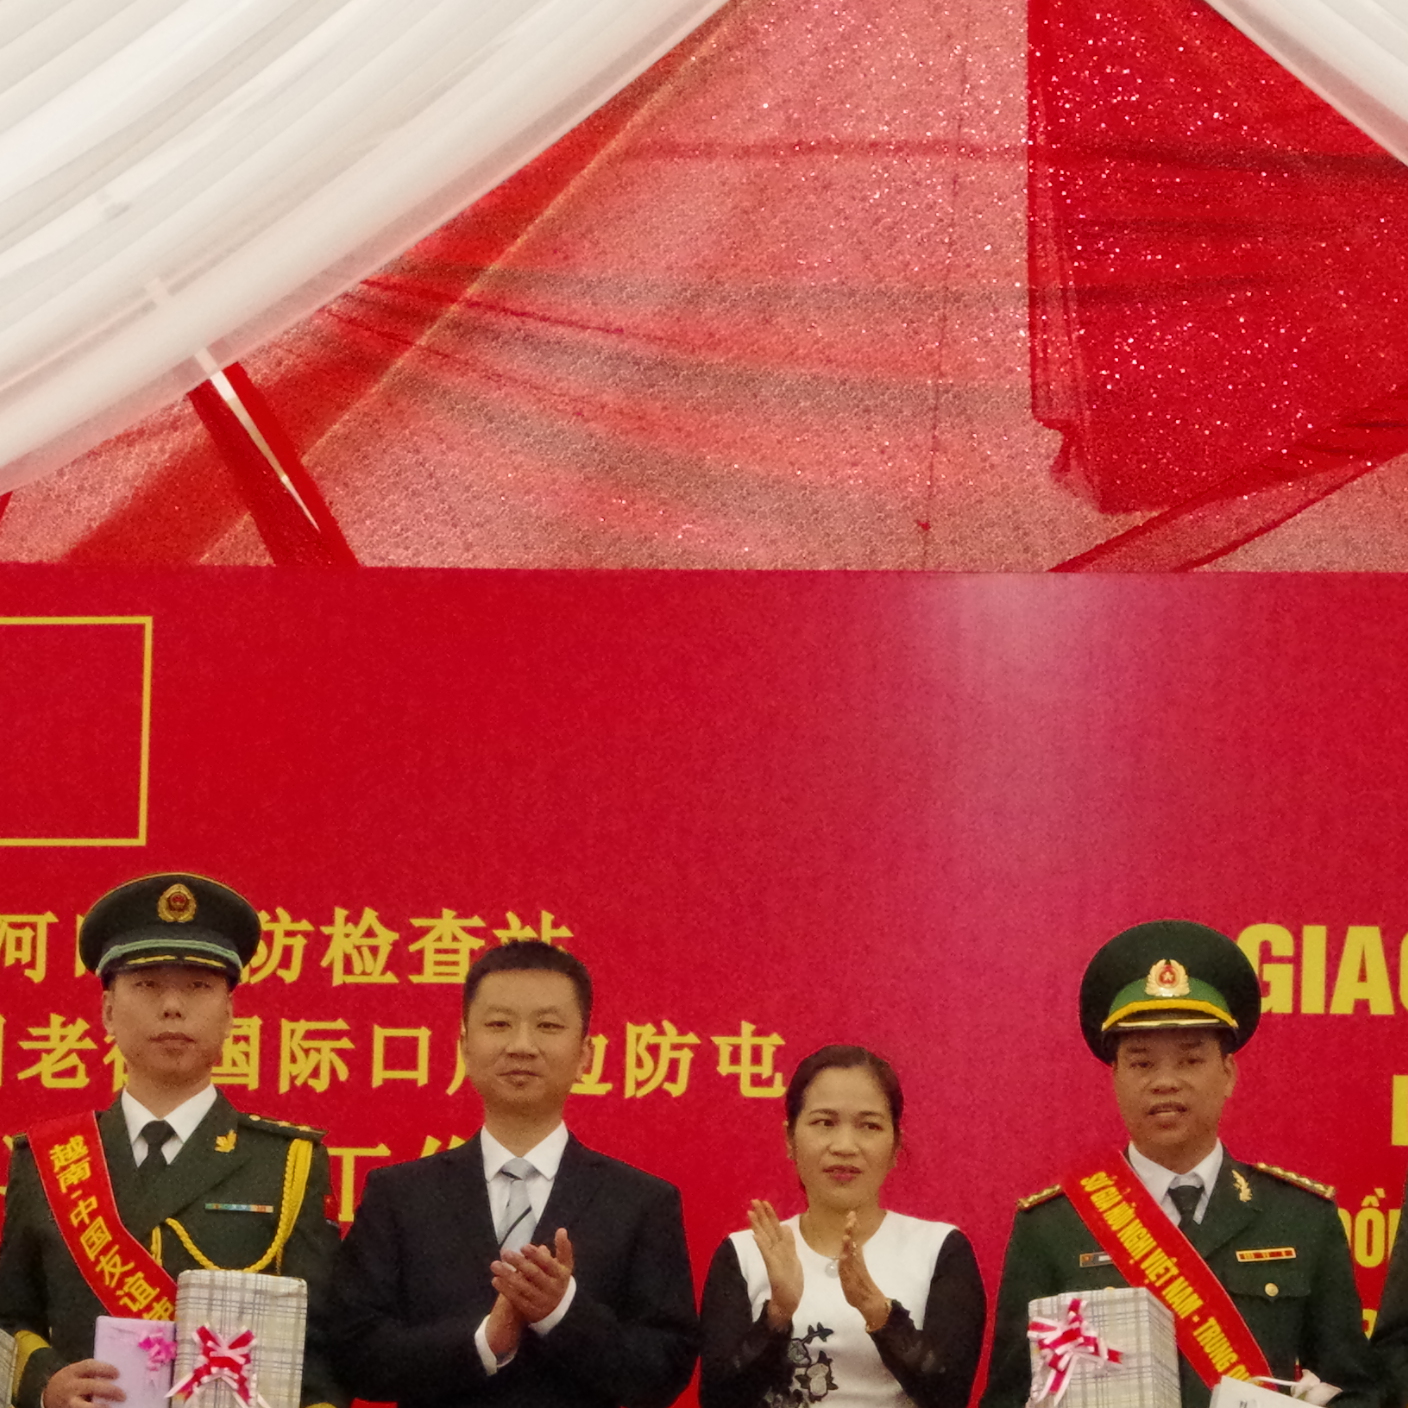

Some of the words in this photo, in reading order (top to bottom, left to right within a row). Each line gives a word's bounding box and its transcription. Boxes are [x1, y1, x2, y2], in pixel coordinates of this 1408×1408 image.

[1140, 1247, 1179, 1287] VIỆT
[1161, 1276, 1204, 1319] NAM
[1193, 1317, 1239, 1373] TRUNG
